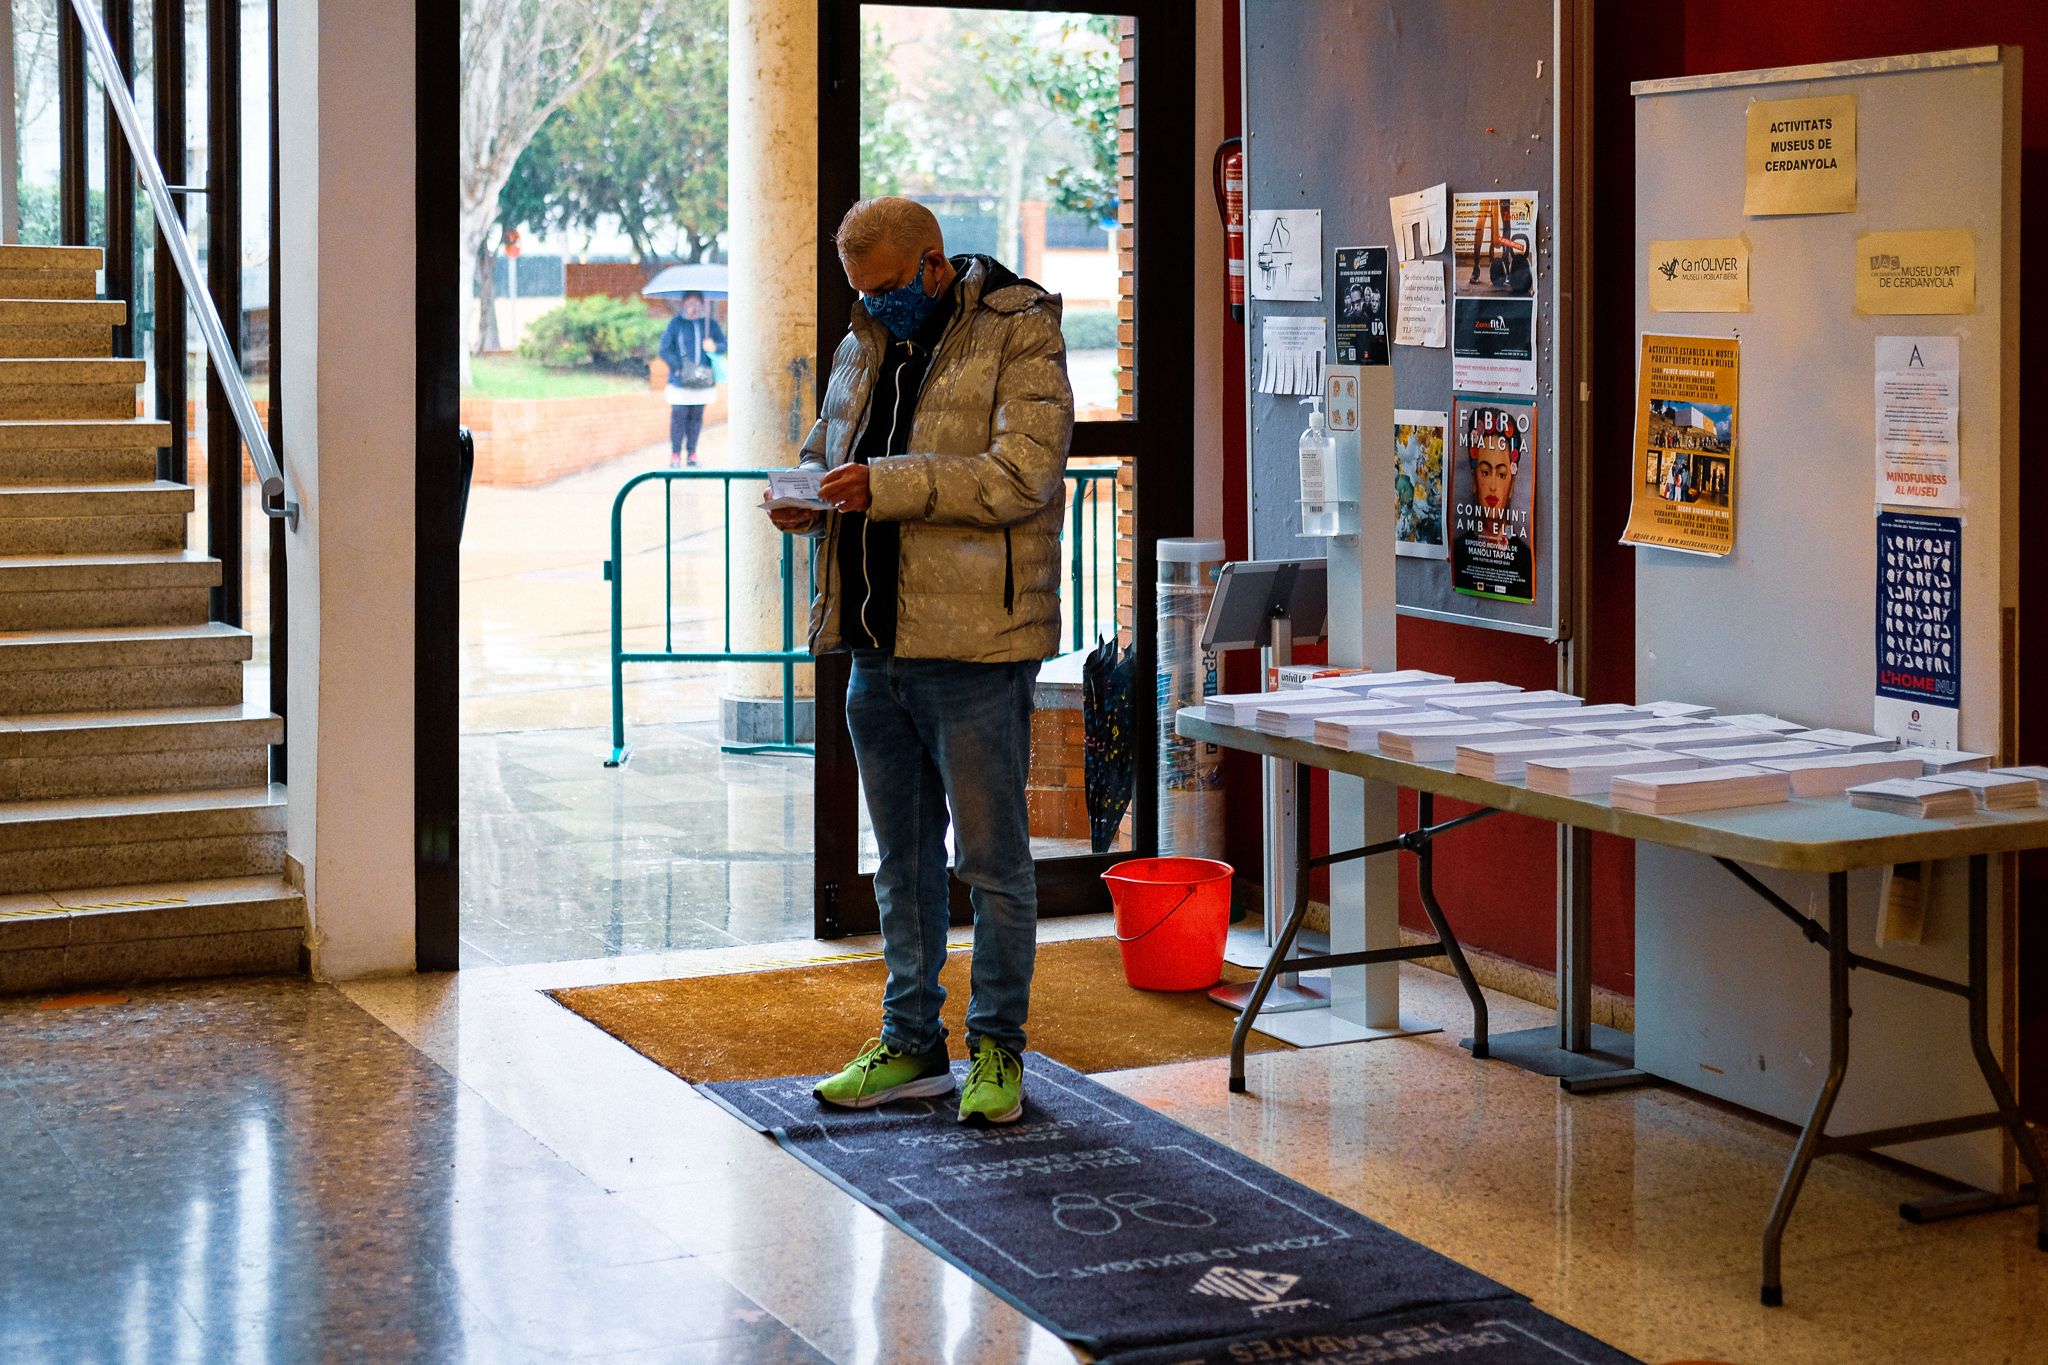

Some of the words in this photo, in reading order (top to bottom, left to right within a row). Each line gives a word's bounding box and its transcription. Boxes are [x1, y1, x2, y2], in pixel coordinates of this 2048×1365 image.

[1770, 118, 1832, 133] ACTIVITATS
[1771, 139, 1814, 152] MUSEUS
[1818, 138, 1832, 149] DE
[1765, 158, 1837, 172] CERDANYOLA
[1681, 258, 1692, 271] Ca
[1694, 257, 1737, 271] n'OLIVER
[1901, 266, 1932, 276] MUSEU
[1934, 266, 1960, 276] D'ART
[1880, 278, 1891, 287] DE
[1893, 278, 1954, 287] CERDANYOLA
[1371, 321, 1385, 336] U2
[1649, 345, 1678, 354] ACTIVITATS
[1680, 347, 1705, 356] ESTABLES
[1707, 349, 1713, 357] AL
[1715, 350, 1734, 358] MUSEU
[1909, 344, 1924, 367] A
[1651, 355, 1672, 363] POBLAT
[1701, 358, 1708, 366] CA
[1710, 359, 1734, 368] N'OLIVER
[1459, 409, 1530, 433] FIBRO
[1459, 433, 1528, 453] MIALGIA
[1886, 472, 1947, 485] MINDFULNESS
[1895, 485, 1905, 495] AL
[1906, 485, 1938, 497] MUSEU
[1456, 503, 1527, 522] CONVIVINT
[1692, 507, 1714, 516] DIUMENGE
[1456, 519, 1483, 533] AMB
[1493, 522, 1527, 538] ELLA
[1690, 528, 1704, 537] MUSEU
[1465, 539, 1487, 548] EXPOSICIÓ
[1487, 542, 1511, 551] INDIVIDUAL
[1468, 546, 1492, 558] MANOLI
[1492, 550, 1515, 561] TAPIAS
[1073, 1147, 1129, 1160] LES
[937, 1153, 1071, 1175] SABATES
[1030, 1156, 1140, 1174] EIXUGA
[1236, 1235, 1328, 1255] ZONA
[1382, 1322, 1449, 1344] LES
[1228, 1334, 1383, 1362] SABATES
